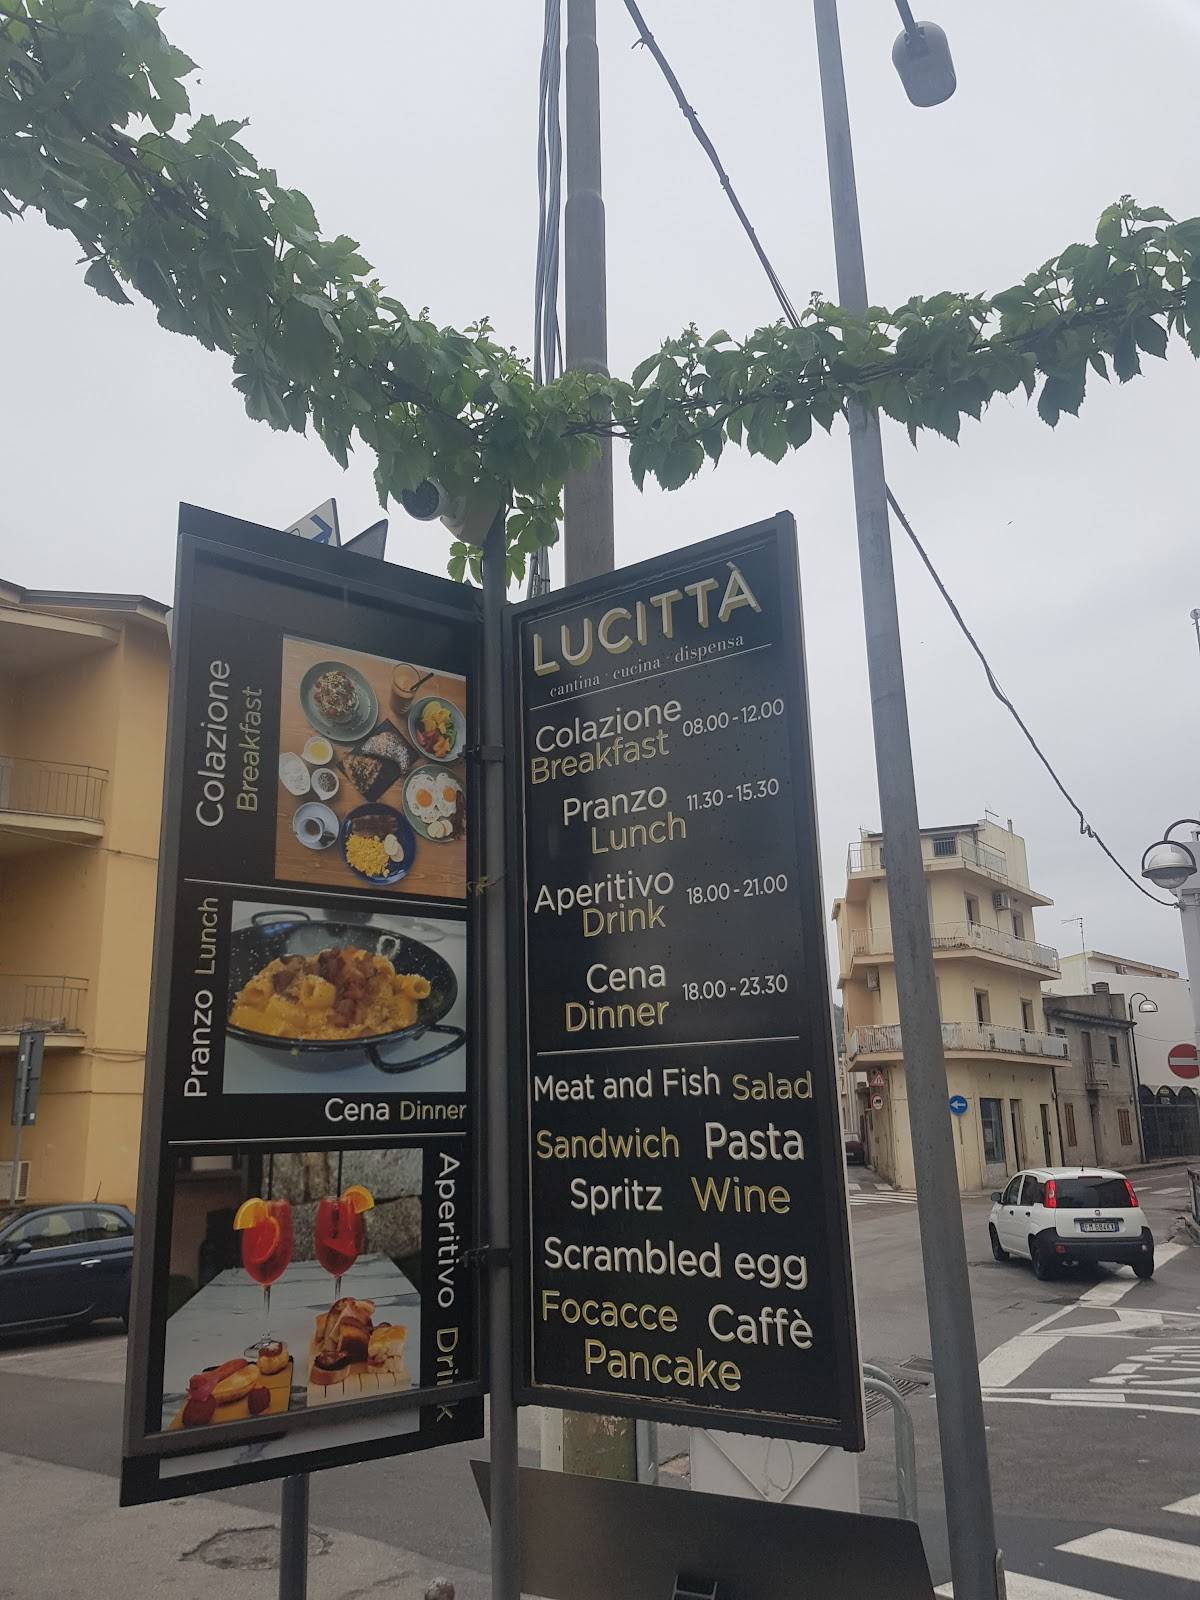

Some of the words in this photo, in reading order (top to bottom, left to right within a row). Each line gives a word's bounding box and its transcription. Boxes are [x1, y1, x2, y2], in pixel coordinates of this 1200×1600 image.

[533, 561, 762, 677] LUCITTÀ
[549, 675, 601, 698] cantina
[613, 657, 661, 681] cucina
[674, 635, 745, 664] dispensa
[195, 660, 231, 828] Colazione
[236, 685, 263, 813] Breakfast
[535, 700, 682, 753] Colazione
[531, 730, 670, 785] Breakfast
[563, 786, 668, 826] Pranzo
[591, 811, 687, 855] Lunch
[534, 870, 674, 916] Aperitivo
[582, 898, 667, 938] Drink
[194, 897, 219, 976] Lunch
[586, 963, 668, 994] Cena
[565, 1000, 670, 1033] Dinner
[182, 990, 214, 1098] Pranzo
[324, 1097, 390, 1123] Cena
[399, 1100, 467, 1122] Dinner
[534, 1074, 595, 1102] Meat
[602, 1069, 653, 1099] and
[662, 1066, 721, 1097] Fish
[732, 1070, 813, 1101] Salad
[536, 1126, 680, 1160] Sandwich
[704, 1121, 806, 1161] Pasta
[570, 1177, 664, 1216] Spritz
[691, 1176, 791, 1214] Wine
[434, 1152, 461, 1309] Aperitivo
[544, 1236, 723, 1279] Scrambled
[734, 1251, 809, 1290] egg
[540, 1289, 679, 1333] Focacce
[707, 1303, 814, 1350] Caffè
[583, 1337, 742, 1392] Pancake
